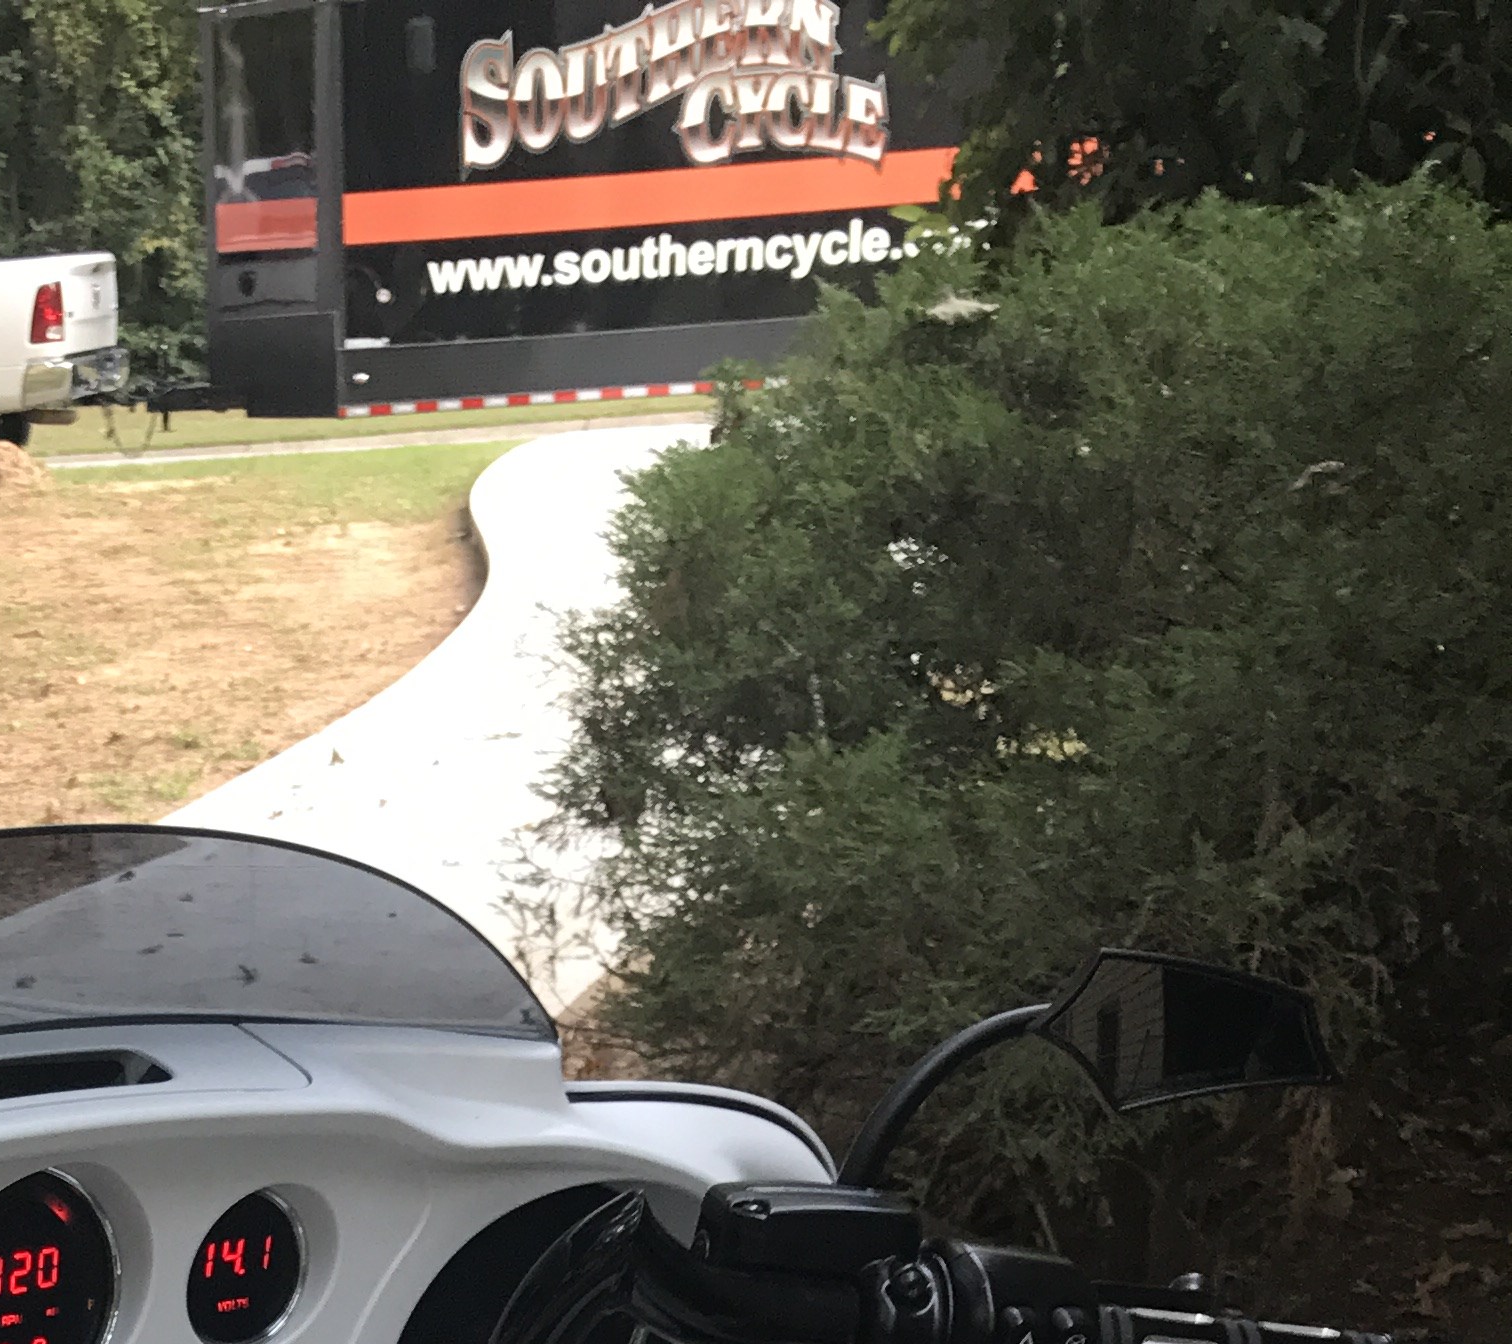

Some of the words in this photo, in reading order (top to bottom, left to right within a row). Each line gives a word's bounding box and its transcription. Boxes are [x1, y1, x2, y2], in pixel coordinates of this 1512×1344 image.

[460, 0, 842, 182] SOUTHERN
[674, 69, 890, 174] CYCLE
[426, 217, 996, 294] www.southerncycle.
[205, 1234, 272, 1278] 14.1
